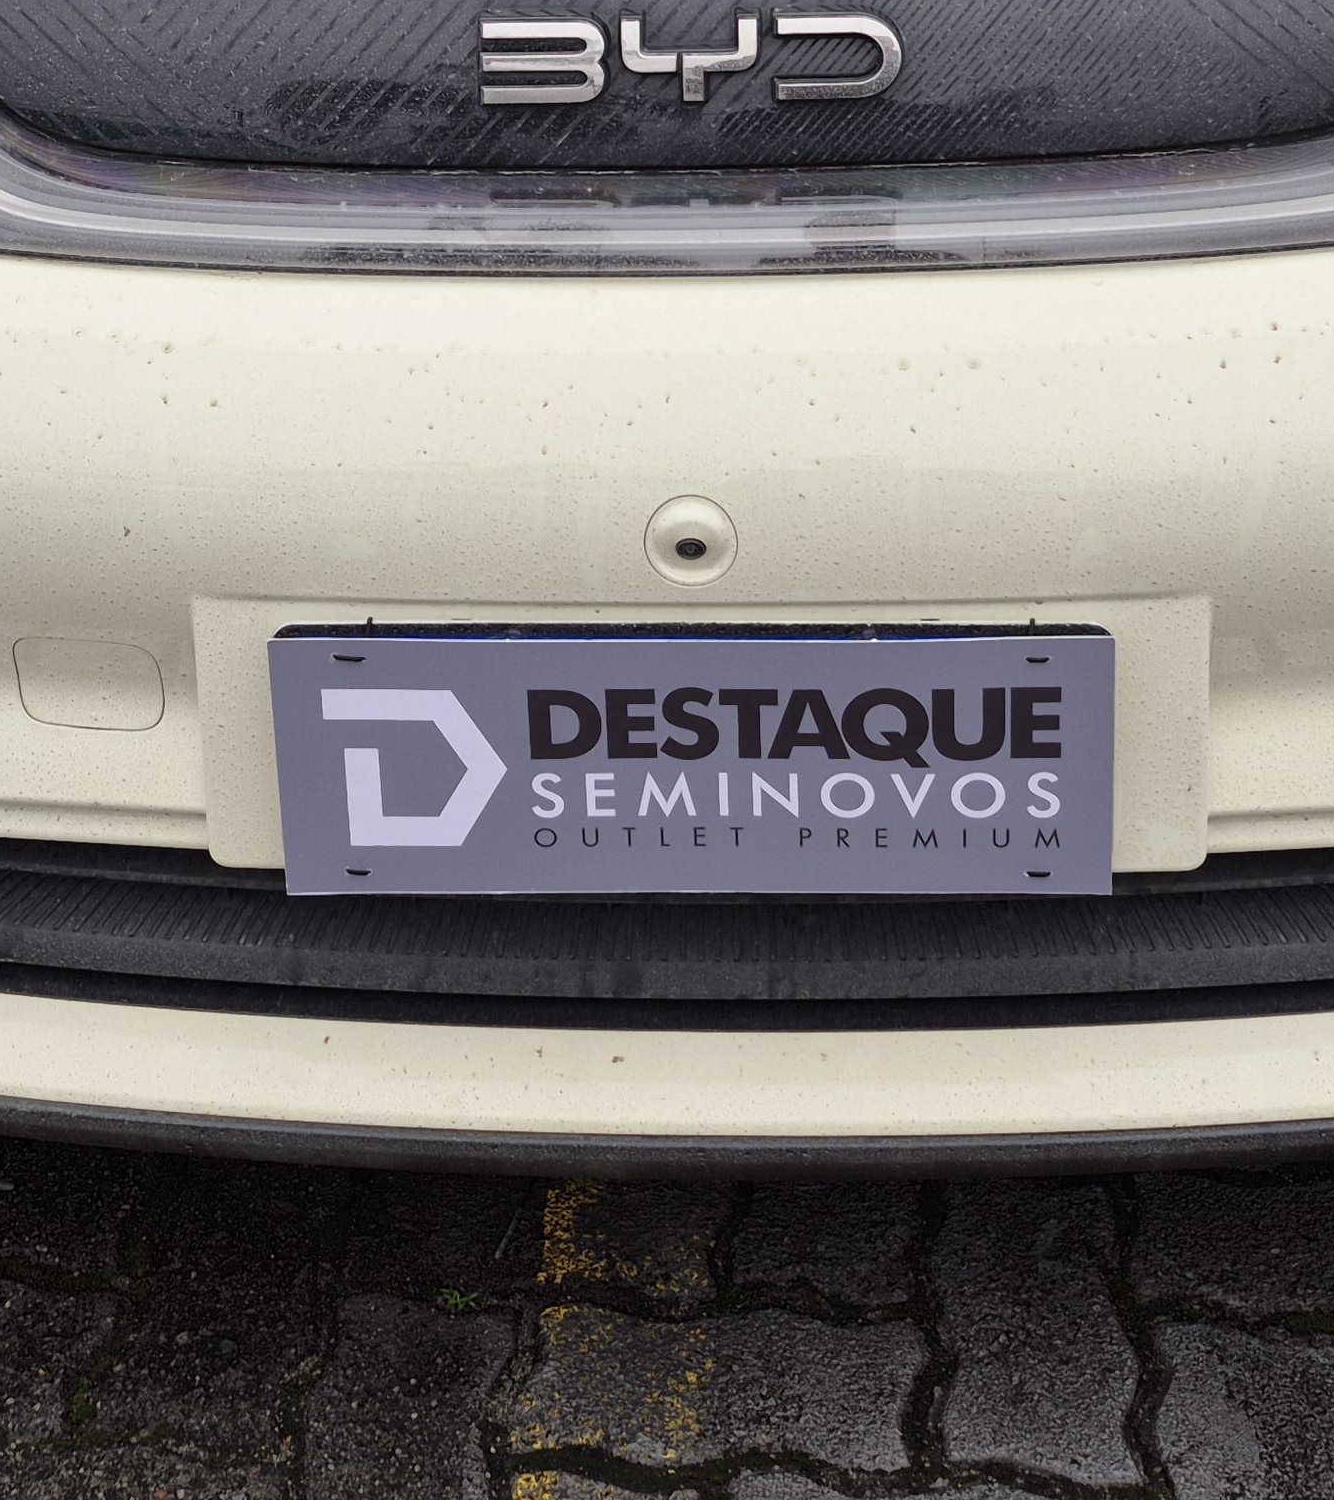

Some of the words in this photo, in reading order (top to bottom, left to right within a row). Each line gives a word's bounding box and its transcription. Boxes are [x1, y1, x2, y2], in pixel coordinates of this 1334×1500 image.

[478, 13, 905, 105] BYD
[526, 686, 1062, 768] DESTAQUE
[531, 771, 1062, 820] SEMINOVOS
[534, 826, 747, 849] OUTLET
[799, 826, 1063, 850] PREMIUM
